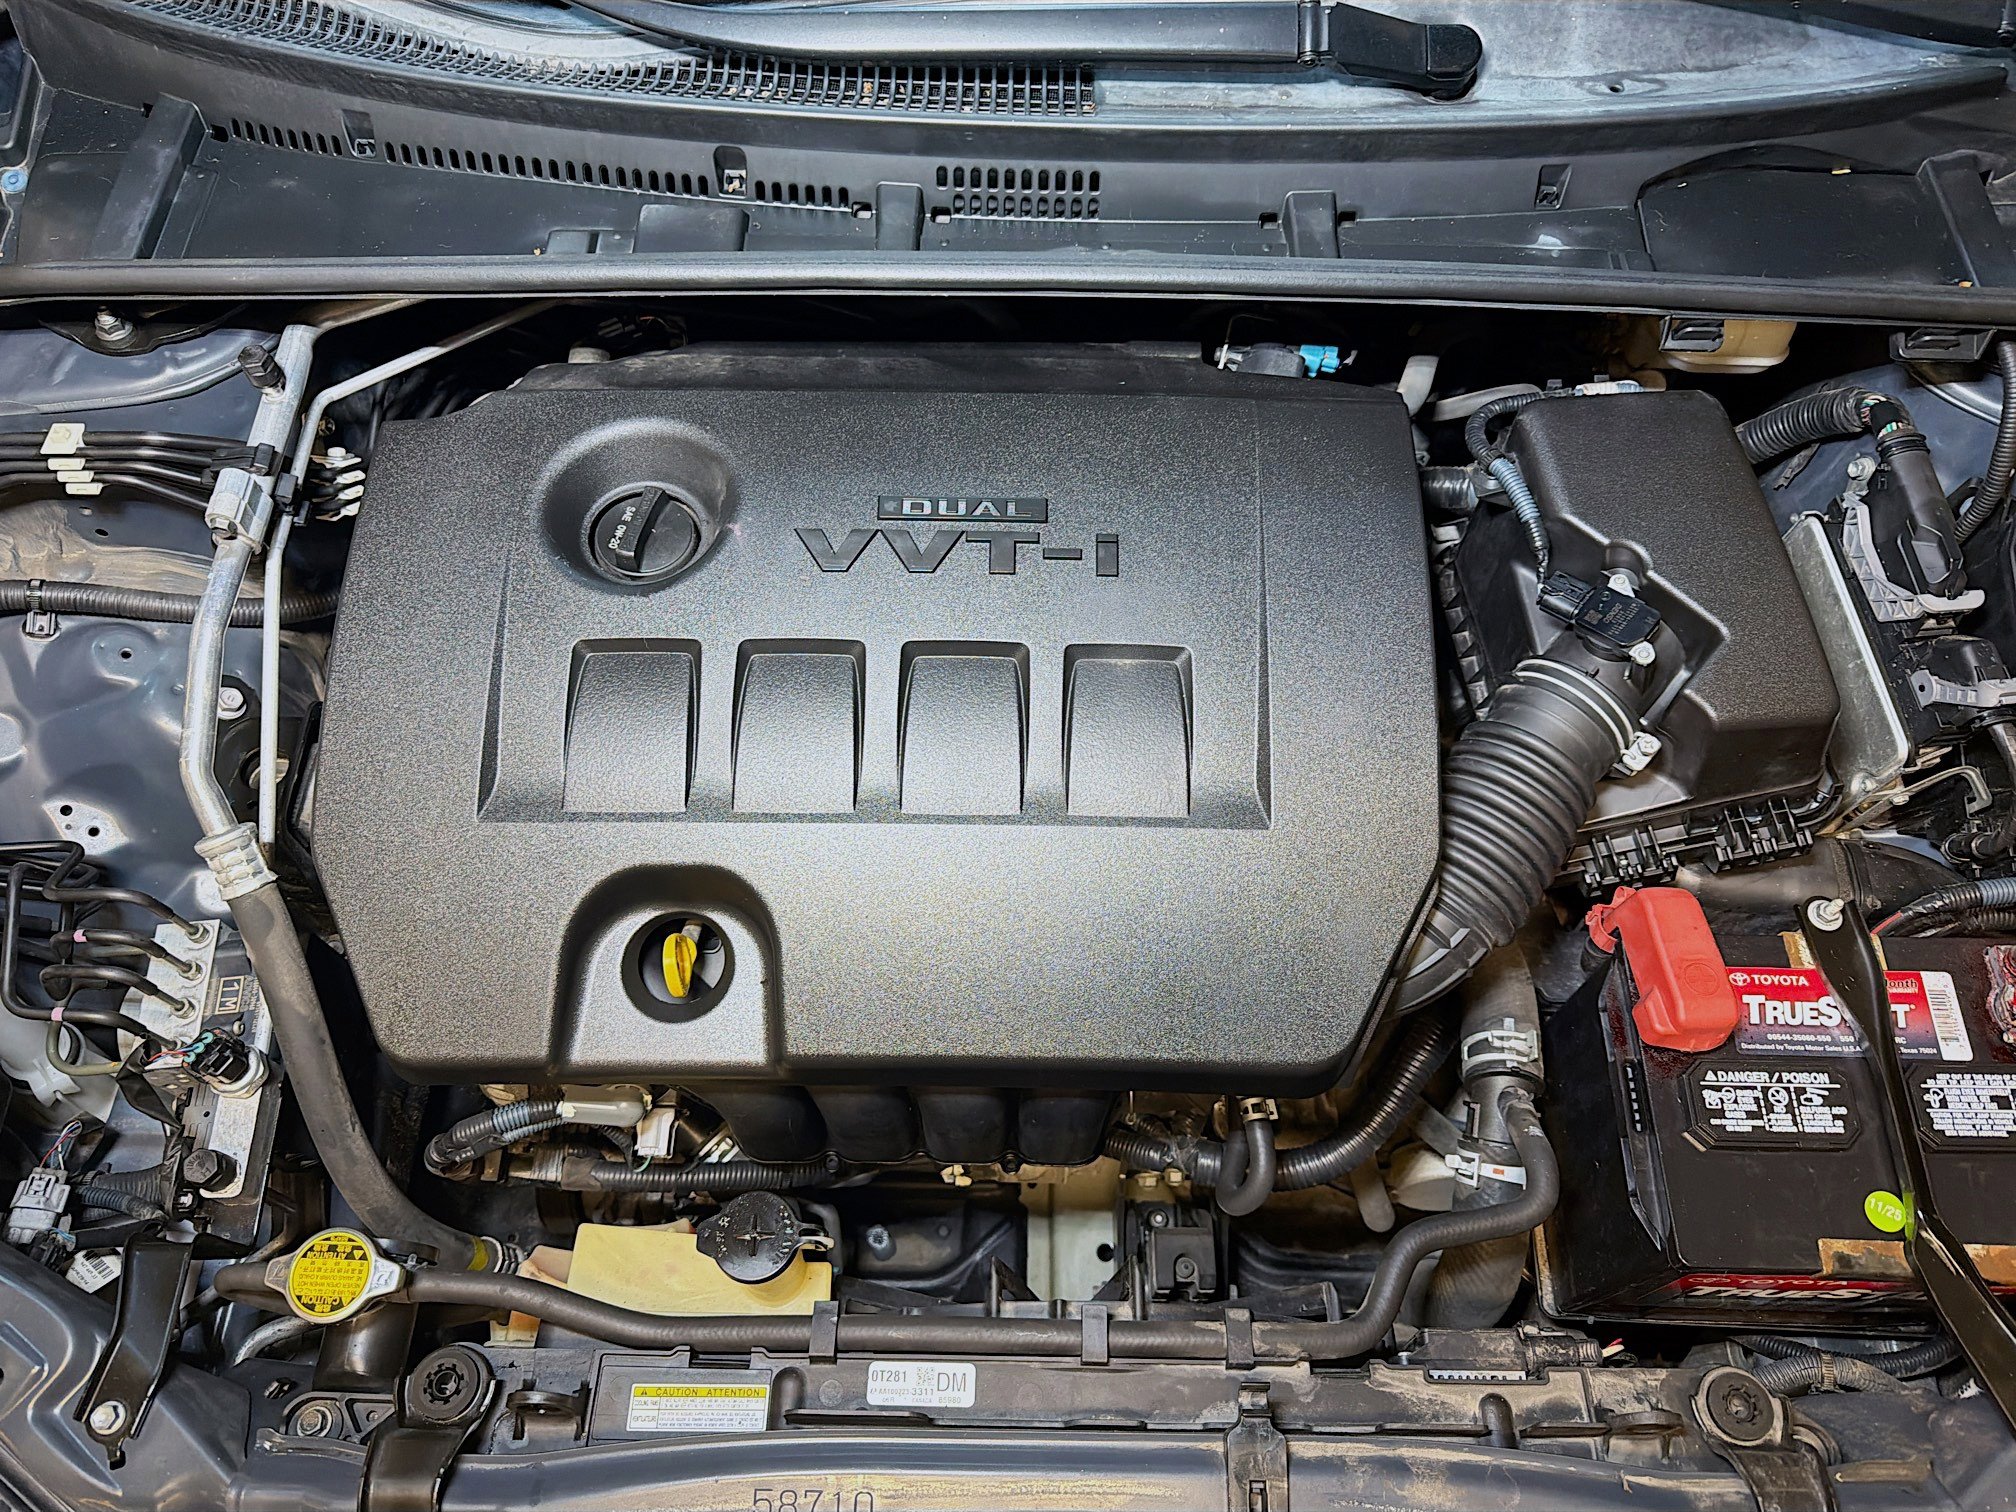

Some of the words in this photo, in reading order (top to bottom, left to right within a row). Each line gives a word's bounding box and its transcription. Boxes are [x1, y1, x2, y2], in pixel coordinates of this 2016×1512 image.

[901, 497, 1031, 517] DUAL
[621, 506, 636, 522] SAE
[608, 524, 627, 550] 0W-20
[1750, 974, 1810, 987] TOYOTA
[1885, 979, 1918, 989] onth
[1839, 1035, 1855, 1043] 550
[1741, 1042, 1775, 1050] Distributed
[1775, 1043, 1784, 1051] by
[1784, 1043, 1805, 1051] Toyota
[1717, 1070, 1770, 1083] DANGER
[1781, 1072, 1830, 1084] POISON
[306, 1251, 347, 1260] ATTENTION
[1737, 1278, 1848, 1286] TOYOTA
[301, 1295, 340, 1305] CAUTION
[937, 1372, 967, 1392] DM
[655, 1388, 698, 1396] CAUTION
[706, 1388, 760, 1397] ATTENTION
[911, 1387, 934, 1396] 3311
[752, 1488, 874, 1512] 58710
